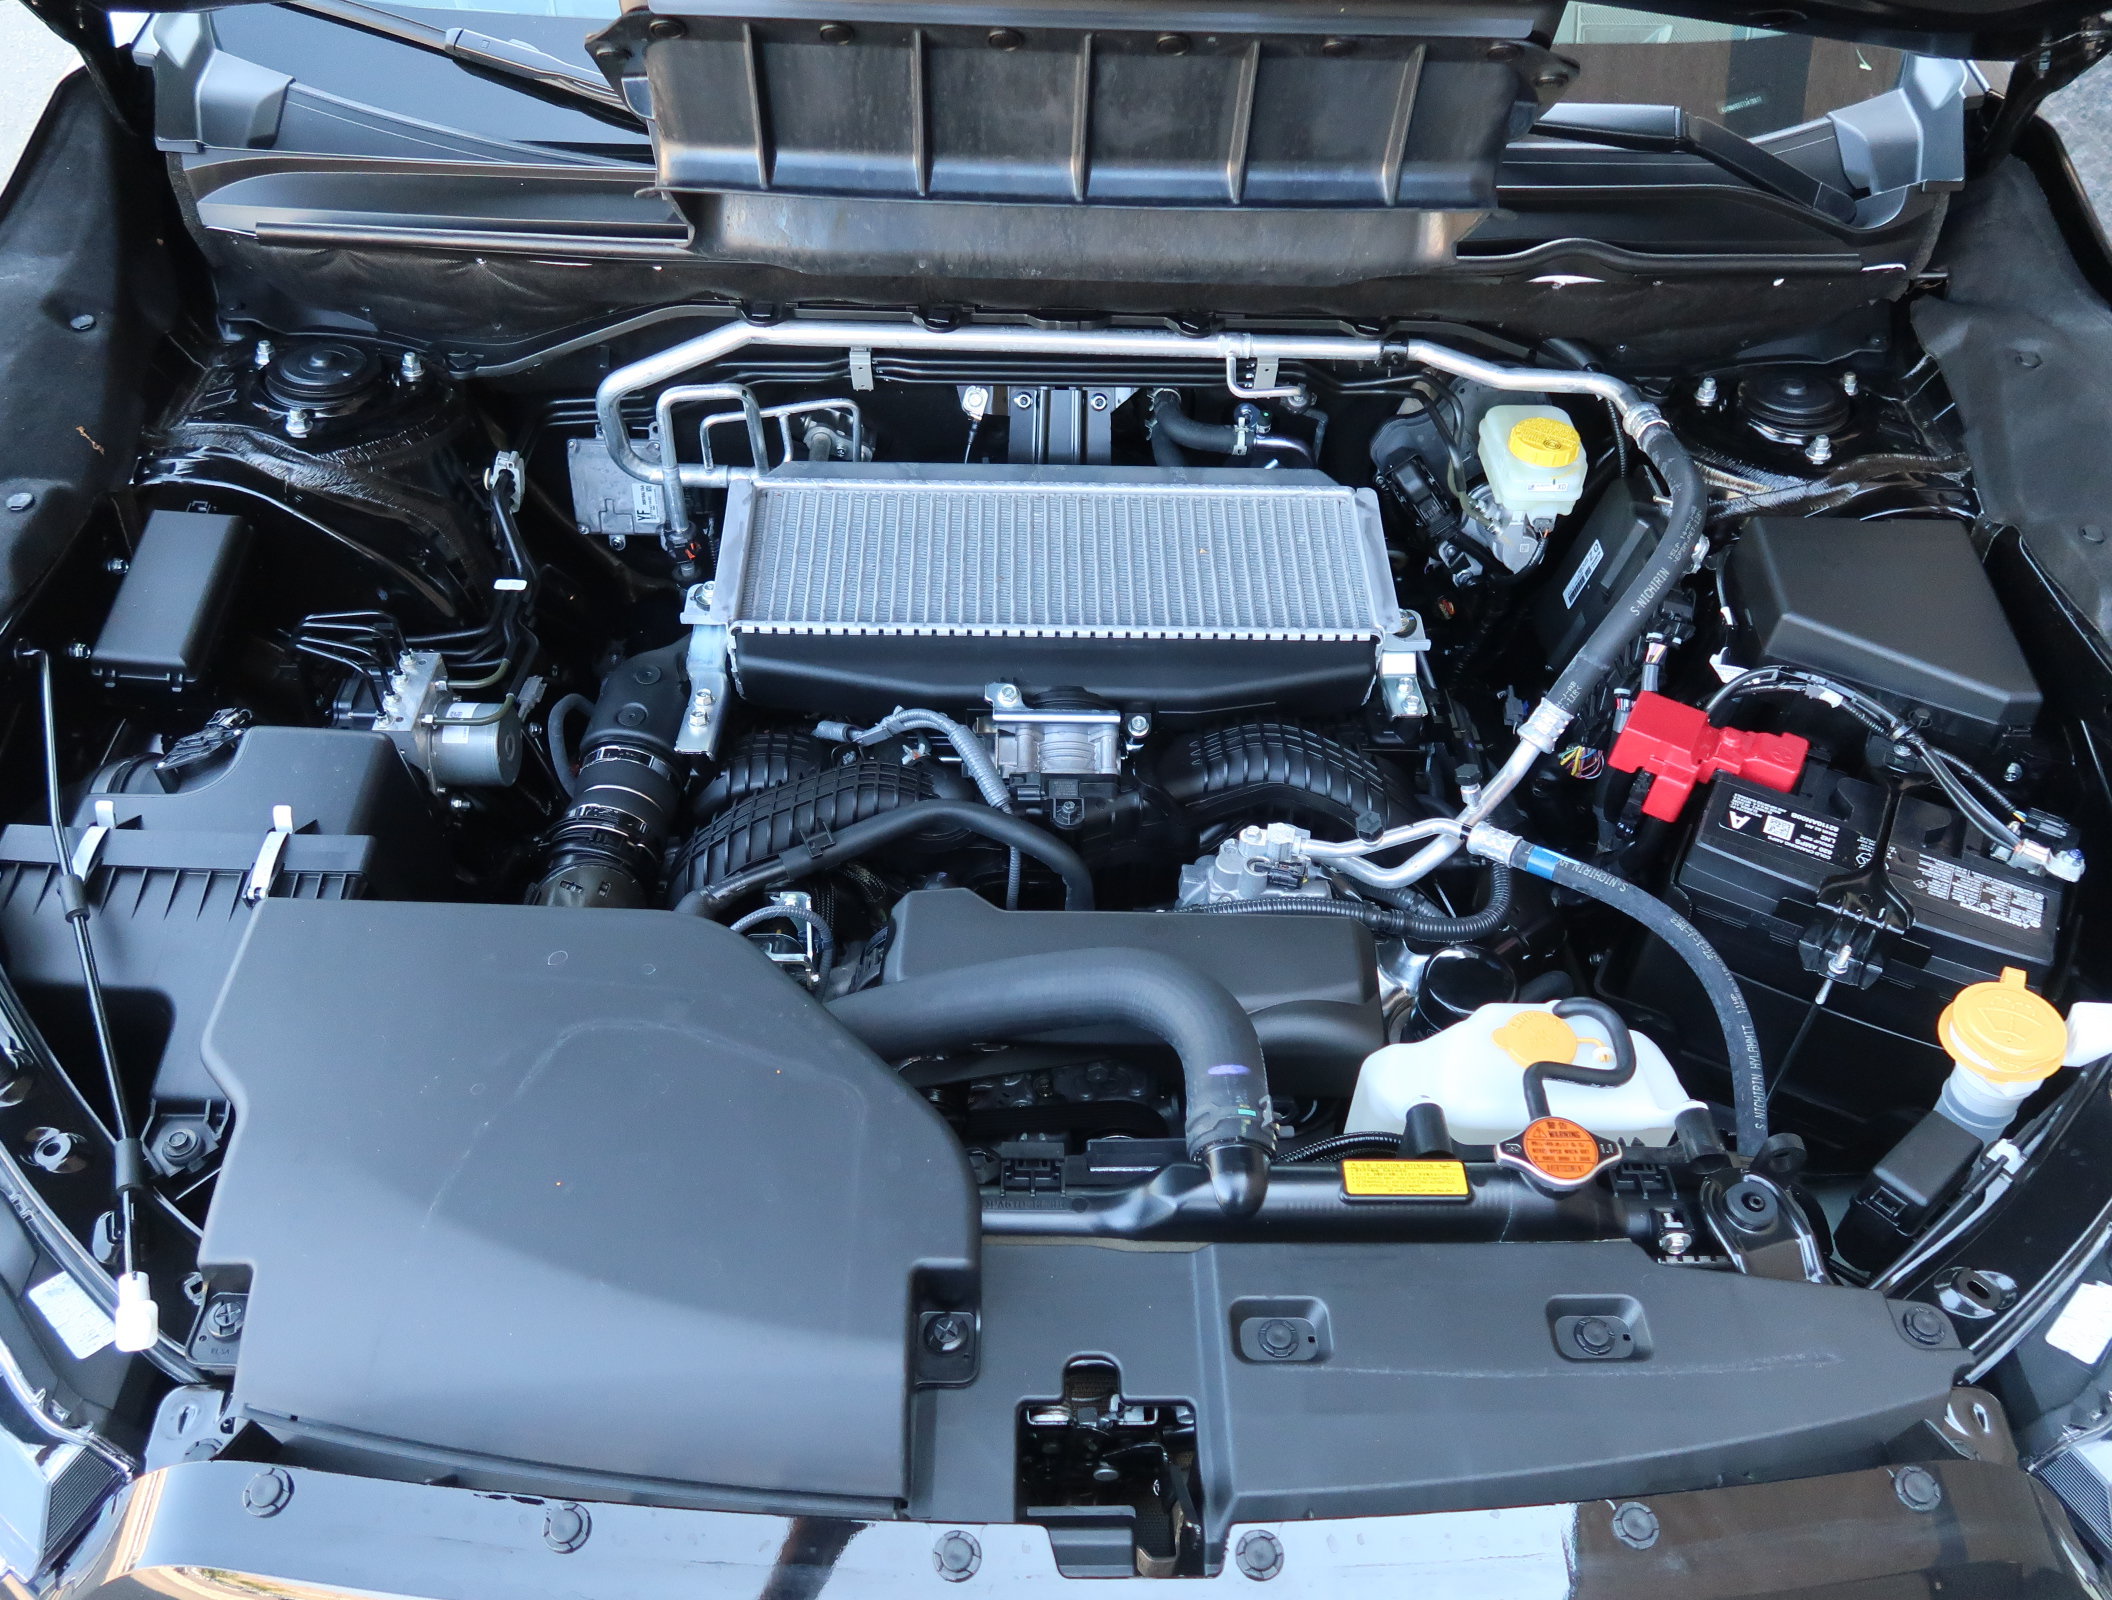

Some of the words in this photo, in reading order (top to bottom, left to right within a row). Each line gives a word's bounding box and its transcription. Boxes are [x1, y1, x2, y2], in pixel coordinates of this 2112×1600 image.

[1729, 811, 1751, 830] A
[1790, 812, 1840, 833] 82110AN00B
[1767, 835, 1784, 844] AMPS
[1800, 834, 1813, 842] SIZE
[1820, 834, 1836, 844] LN2
[1784, 840, 1814, 854] CRANKING
[1794, 837, 1818, 850] AMPS
[1813, 838, 1835, 849] GROUP
[1814, 850, 1832, 860] COLD
[1818, 846, 1833, 855] 620
